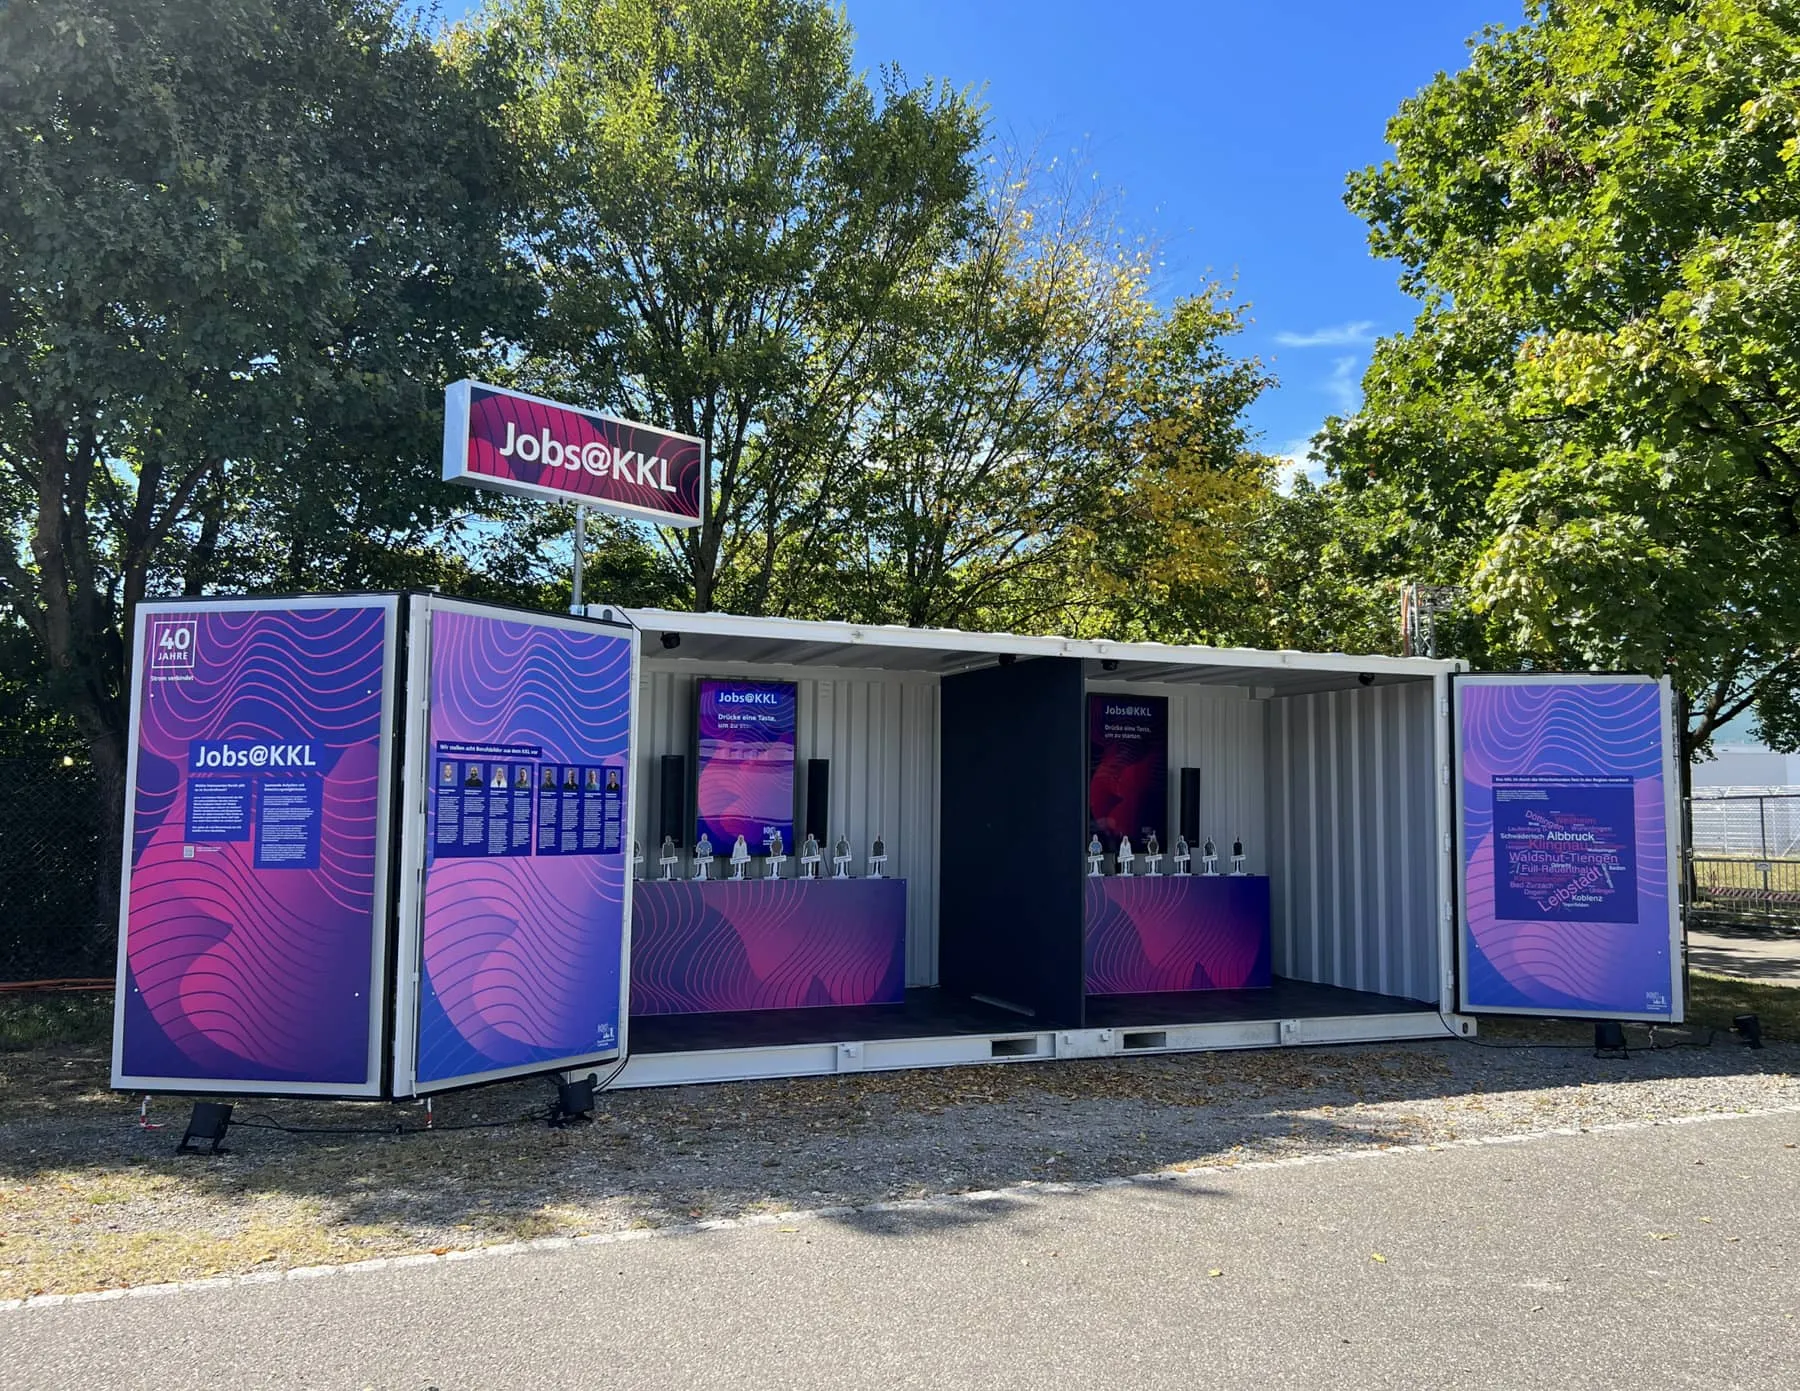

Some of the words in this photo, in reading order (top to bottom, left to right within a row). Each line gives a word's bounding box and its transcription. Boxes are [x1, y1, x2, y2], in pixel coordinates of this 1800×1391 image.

[499, 421, 677, 493] Jobs@KKL
[159, 628, 191, 650] 40
[158, 651, 189, 661] JAHRE
[719, 691, 778, 704] Jobs@KKL
[718, 713, 741, 721] Drücke
[1104, 704, 1152, 717] Jobs@KKL
[195, 744, 317, 767] Jobs@KKL
[1547, 831, 1595, 841] Albbruck
[1528, 840, 1590, 853] Klingnau
[1509, 851, 1618, 865] Waldshut-Tiengen
[1537, 865, 1603, 912] Leibstadt
[1572, 894, 1604, 902] Koblenz
